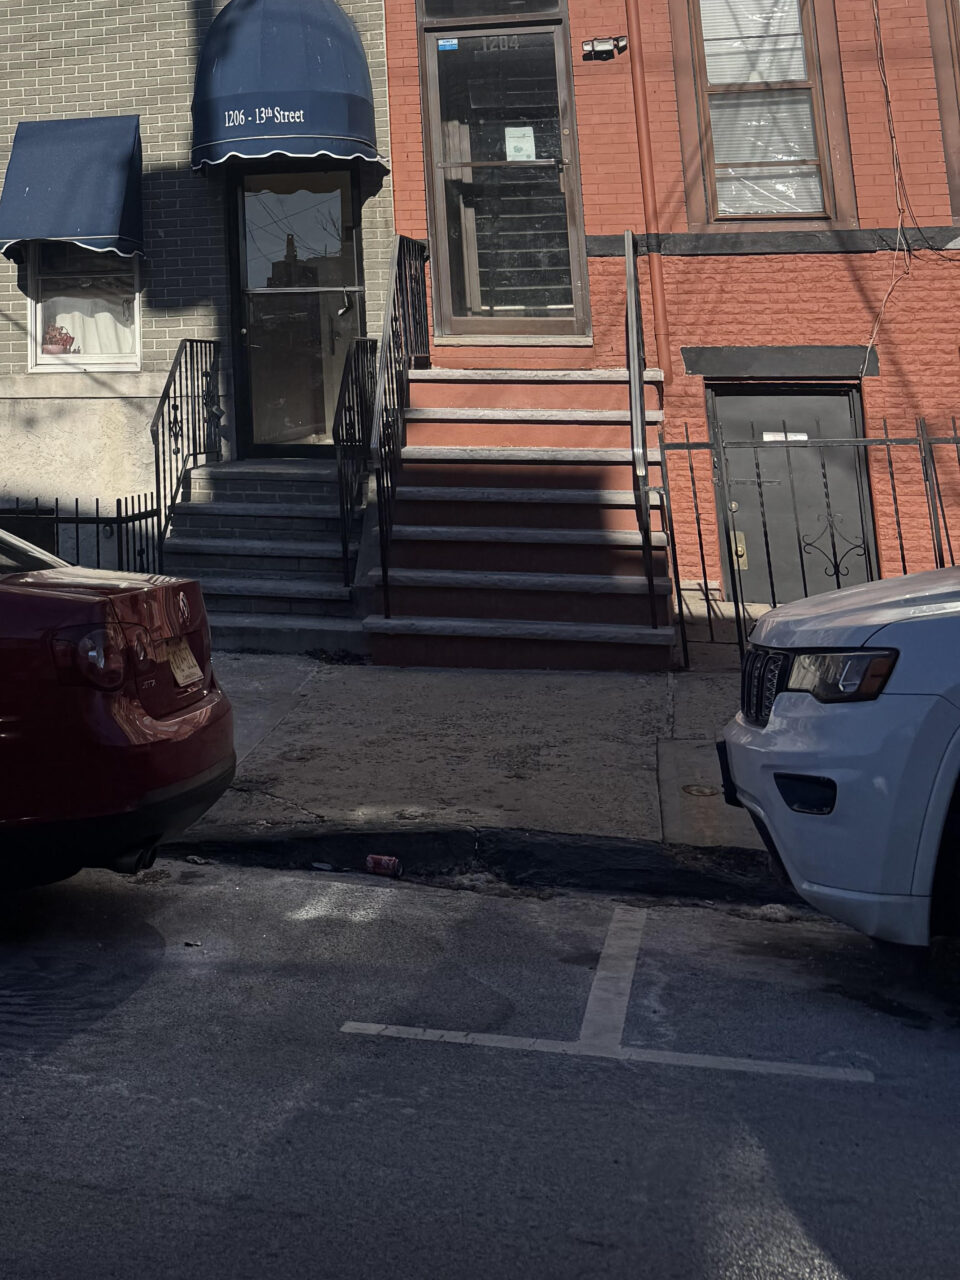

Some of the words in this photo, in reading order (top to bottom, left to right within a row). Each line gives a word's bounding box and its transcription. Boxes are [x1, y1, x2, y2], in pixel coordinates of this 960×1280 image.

[481, 35, 520, 51] 1204
[224, 110, 245, 127] 1206
[255, 107, 273, 124] 13th
[274, 107, 305, 123] Street
